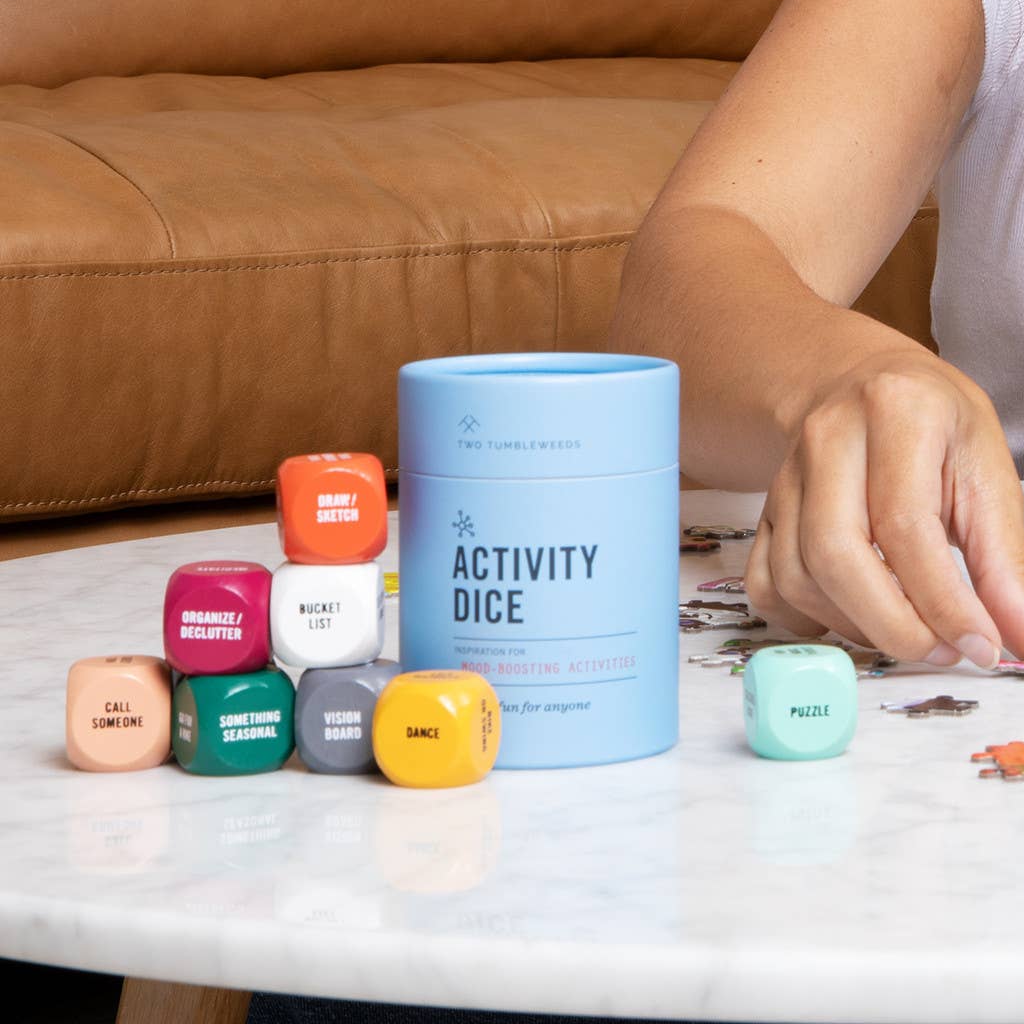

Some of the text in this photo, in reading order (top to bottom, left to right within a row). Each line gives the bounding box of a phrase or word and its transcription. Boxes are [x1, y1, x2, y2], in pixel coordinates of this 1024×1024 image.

[457, 439, 581, 451] TWO TUMBLEWEEDS
[317, 493, 357, 507] DRAW/
[316, 508, 359, 523] SKETCH
[452, 544, 598, 581] ACTIVITY
[299, 602, 341, 615] BUCKET
[454, 587, 524, 624] DICE
[181, 610, 243, 625] ORGANIZE/
[308, 617, 332, 630] LIST
[180, 626, 242, 641] DECLUTTER
[454, 645, 526, 657] INSPIRATION FOR
[461, 655, 636, 675] MOOD-BOOSTING ACTIVITIES
[105, 701, 131, 713] CALL
[519, 700, 541, 716] for
[543, 700, 592, 715] anyone
[790, 704, 830, 717] PUZZLE
[92, 715, 144, 729] SOMEONE
[219, 710, 281, 729] SOMETHING
[324, 711, 362, 725] VISION
[222, 726, 278, 743] SEASONAL
[324, 726, 362, 741] BOARD
[406, 726, 440, 739] DANCE
